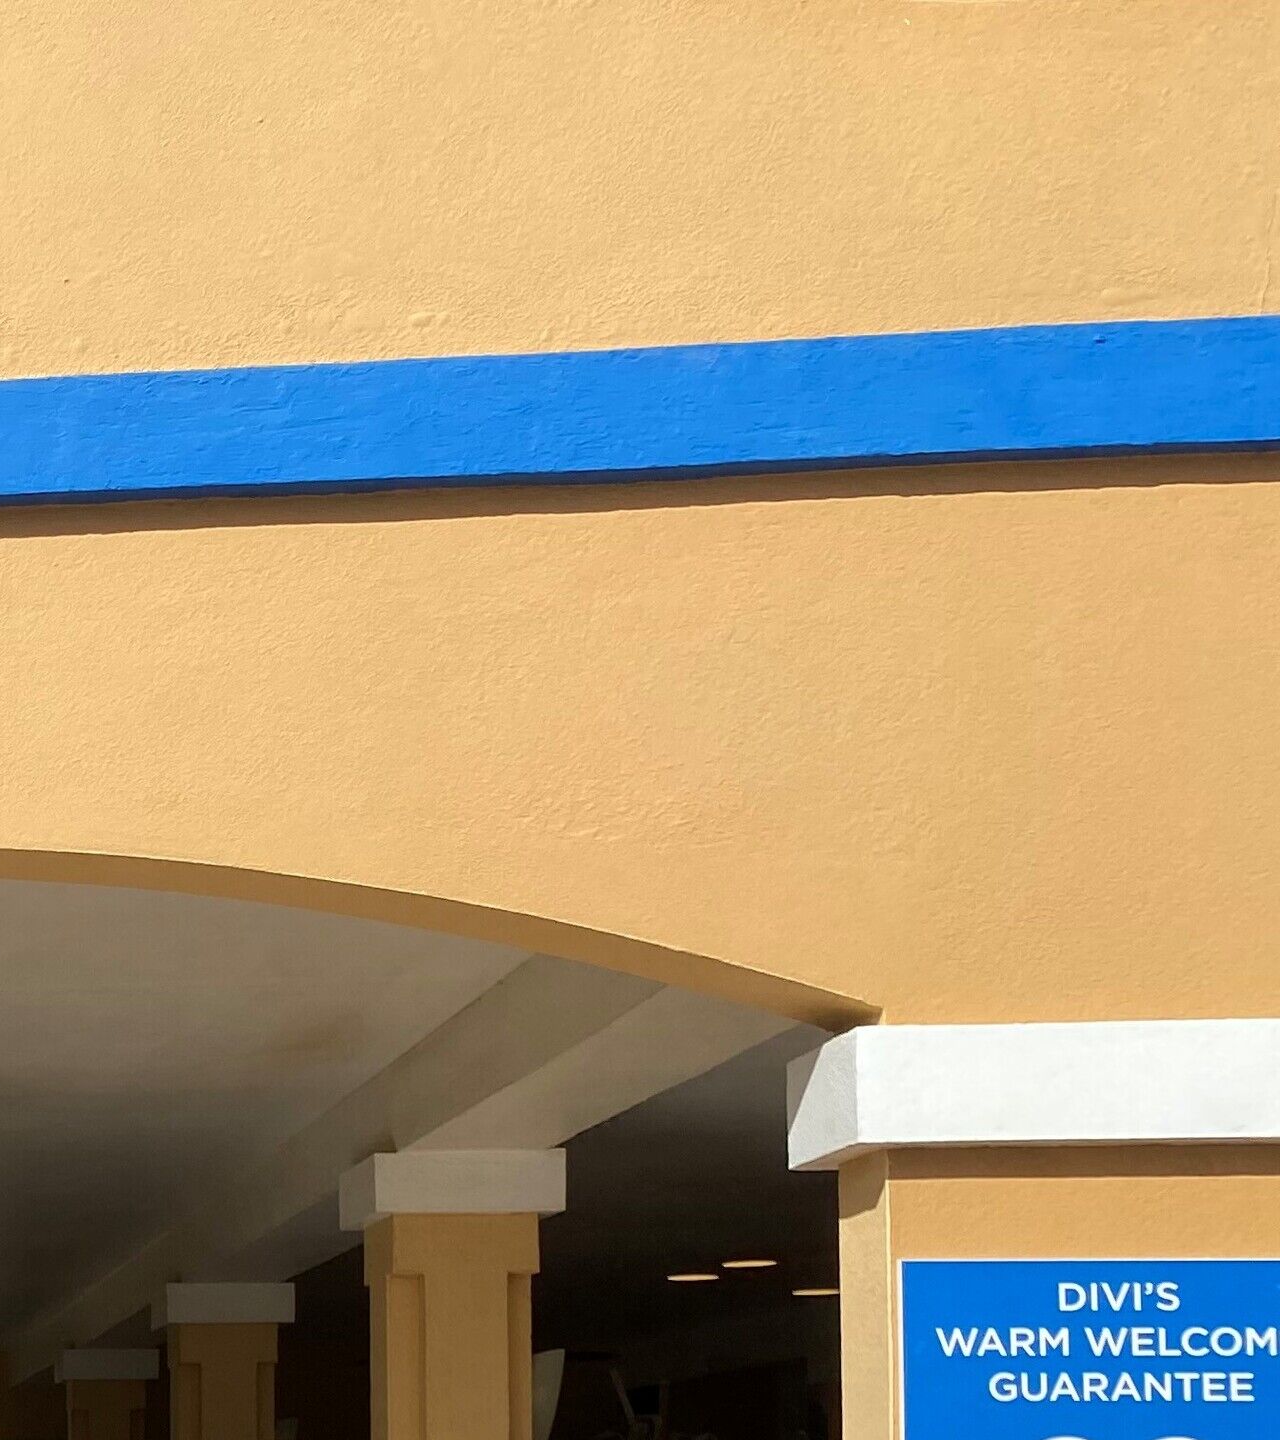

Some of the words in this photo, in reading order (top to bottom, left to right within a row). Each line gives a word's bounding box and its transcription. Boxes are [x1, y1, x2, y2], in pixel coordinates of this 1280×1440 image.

[1057, 1281, 1181, 1312] DIVI'S
[936, 1326, 1070, 1357] WARM
[1084, 1326, 1278, 1357] WELCOM
[989, 1372, 1255, 1402] GUARANTEE
